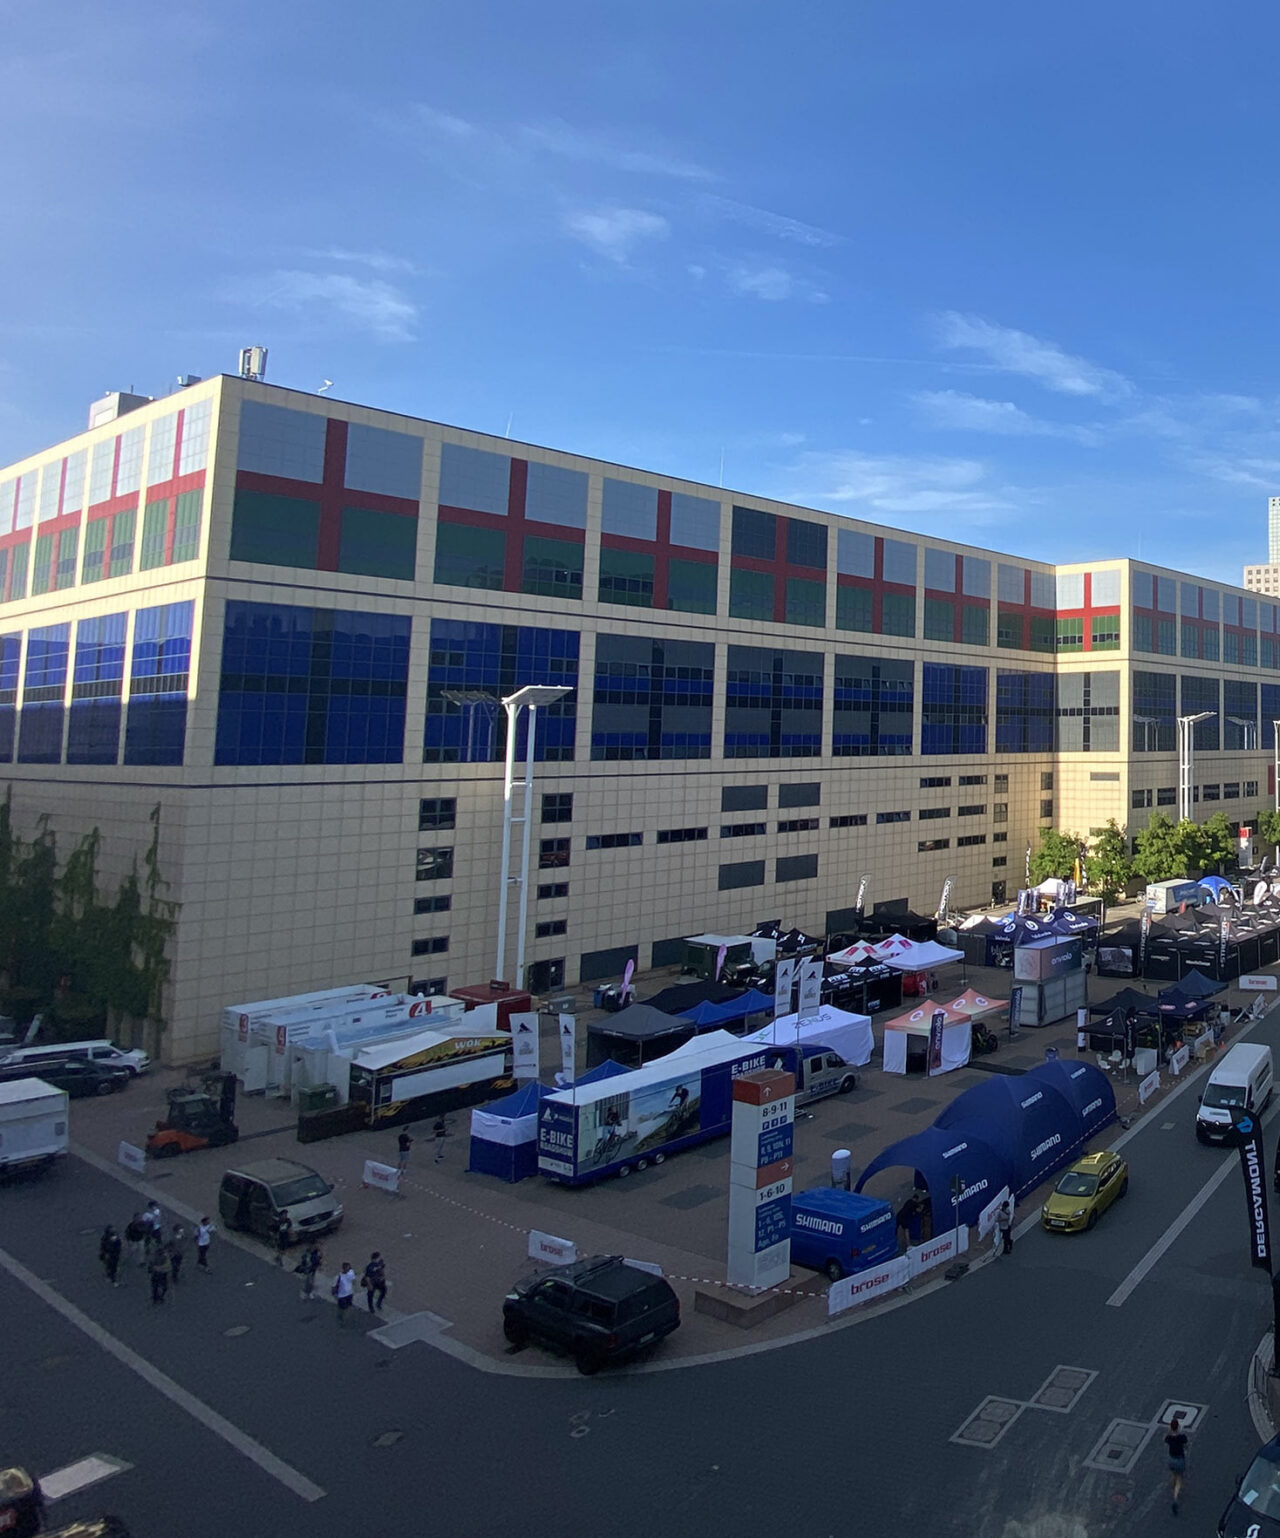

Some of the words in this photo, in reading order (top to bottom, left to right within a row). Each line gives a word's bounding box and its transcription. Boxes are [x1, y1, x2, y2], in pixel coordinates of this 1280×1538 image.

[1051, 951, 1073, 965] enviolo
[731, 1055, 766, 1075] E-BIKE
[1021, 1091, 1043, 1109] SHIMANO
[540, 1128, 573, 1147] E-BIKE
[1030, 1133, 1061, 1161] SHIMANO
[942, 1142, 967, 1160] SHIMANO
[951, 1178, 988, 1207] SHIMANO
[795, 1213, 843, 1236] SHIMANO
[860, 1212, 892, 1233] SHIMANO
[921, 1241, 952, 1263] brose
[851, 1272, 890, 1296] brose
